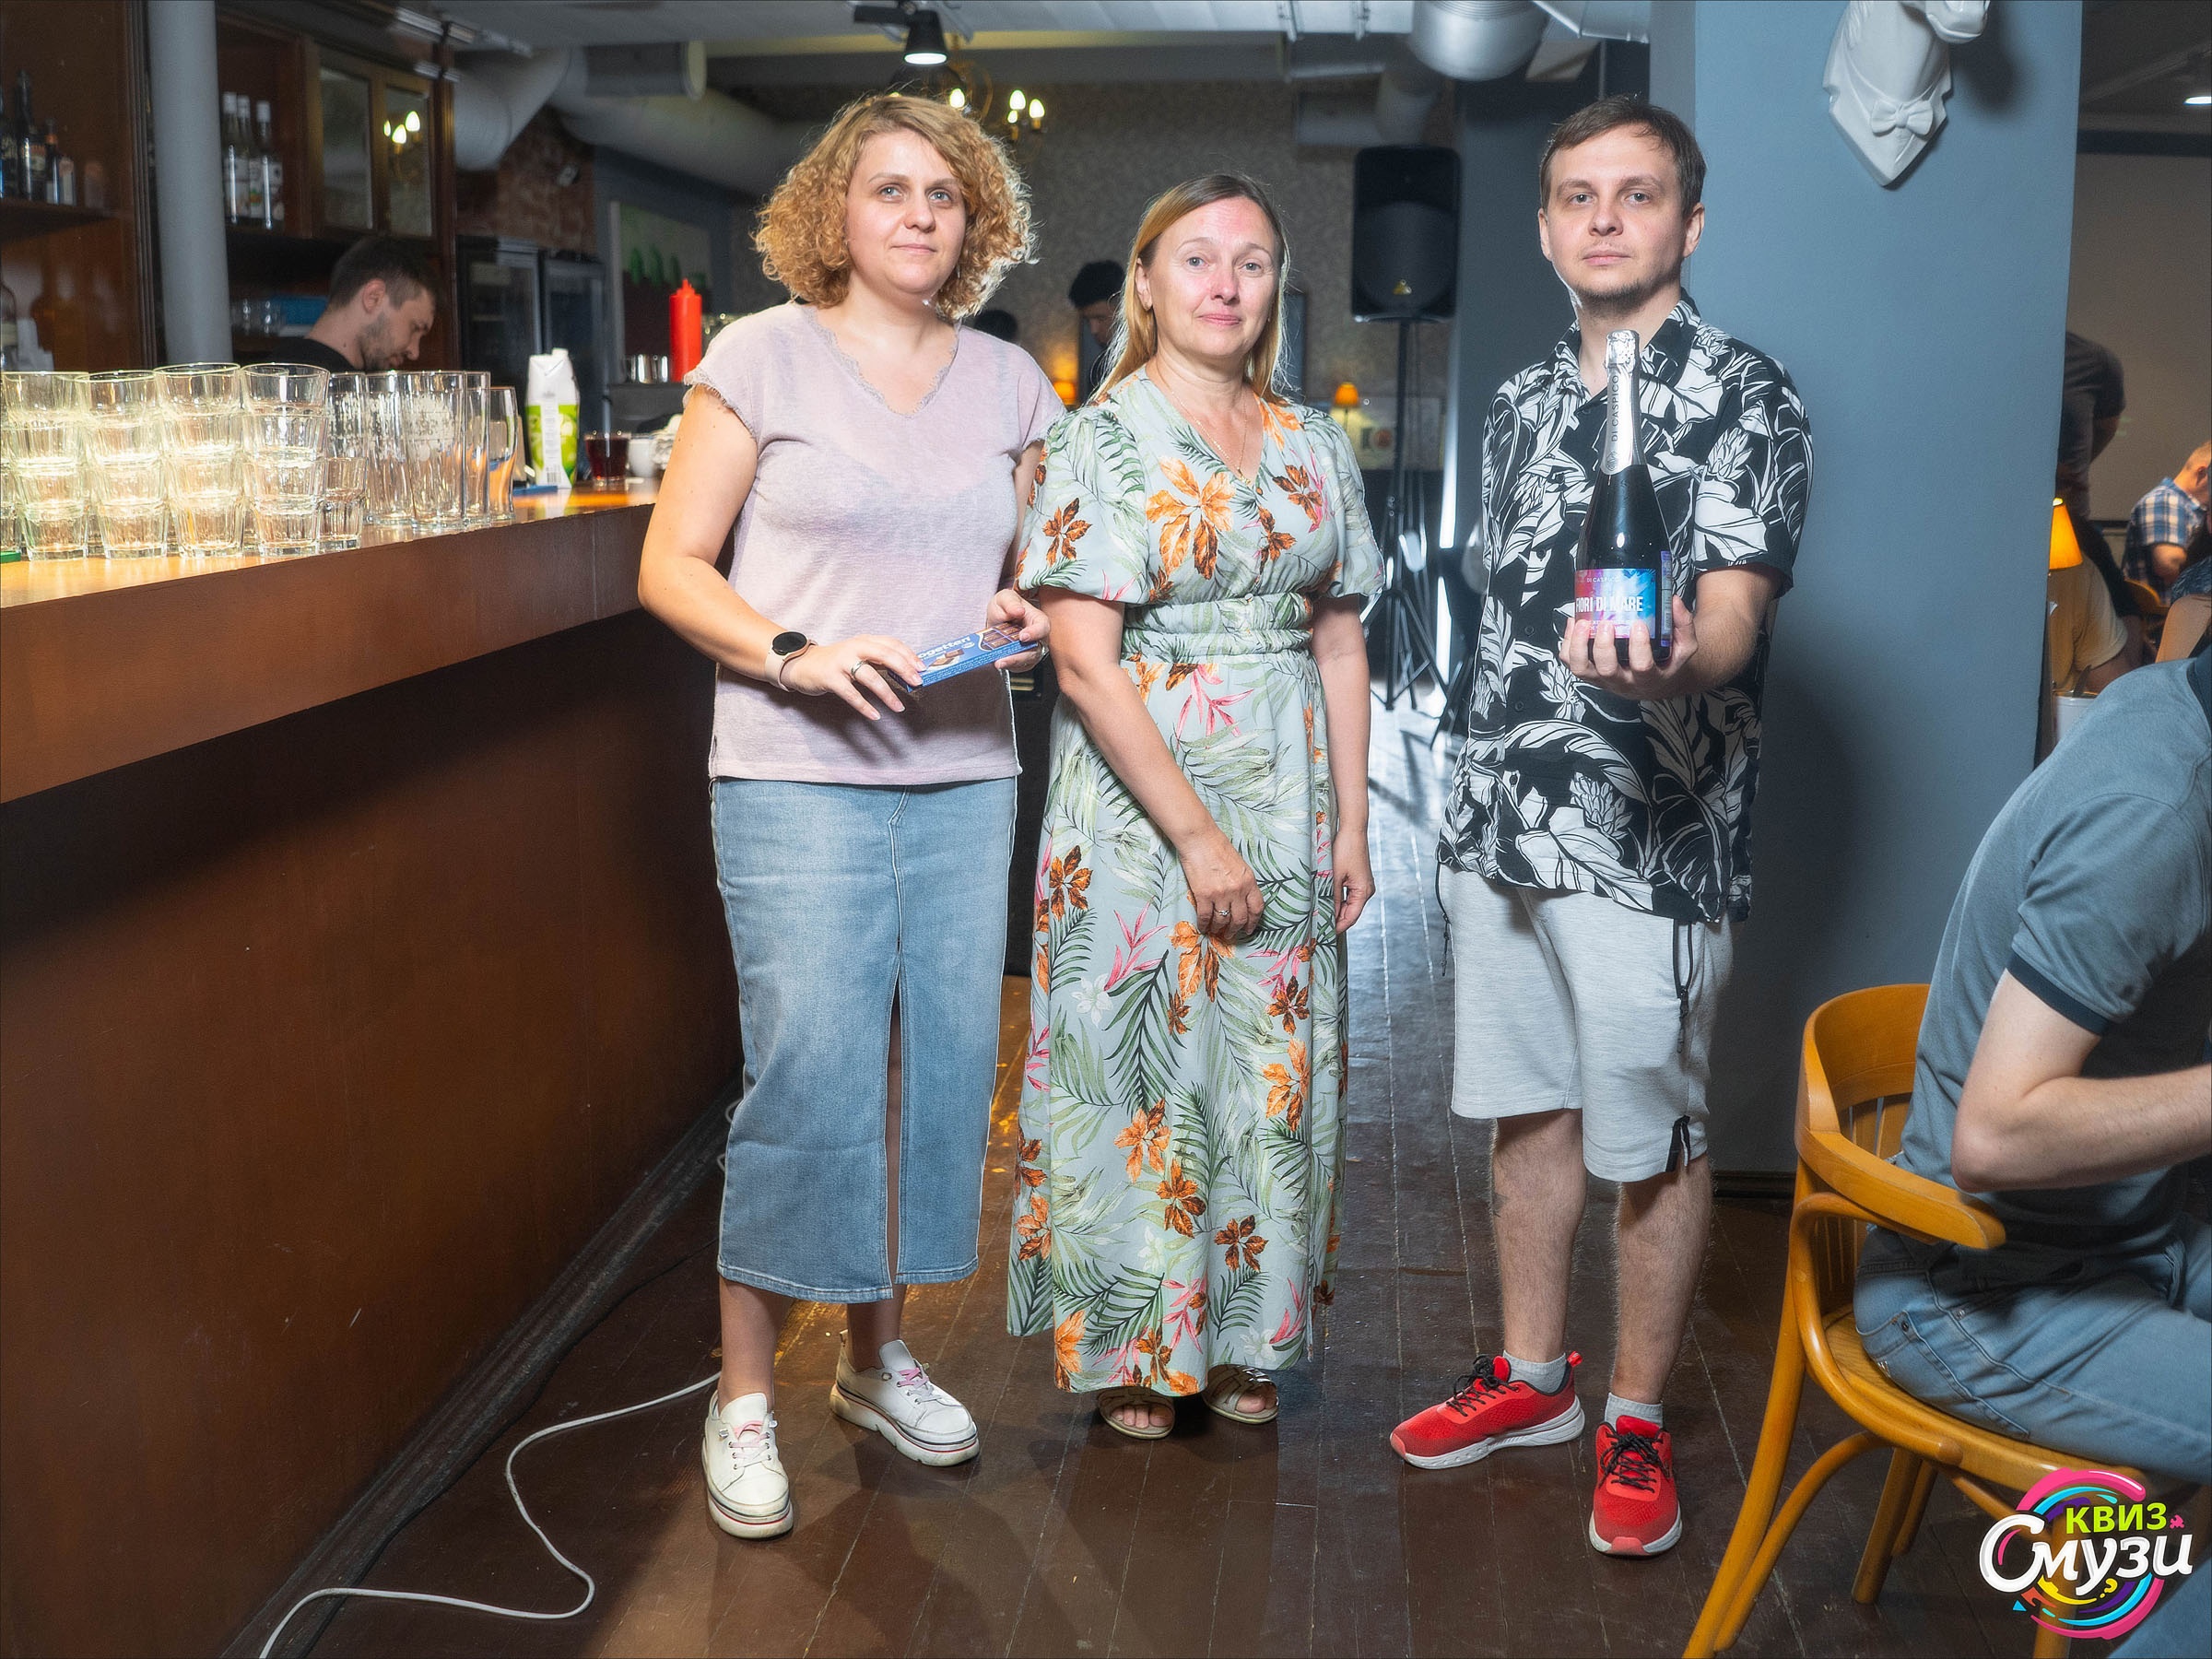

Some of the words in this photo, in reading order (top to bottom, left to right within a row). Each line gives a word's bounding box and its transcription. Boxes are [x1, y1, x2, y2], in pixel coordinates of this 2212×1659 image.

[1611, 375, 1619, 427] CASPICO
[1611, 430, 1618, 441] DI
[1575, 596, 1594, 613] FIORI
[1595, 596, 1607, 612] DI
[1610, 595, 1644, 612] MARE
[917, 636, 971, 659] ogetten
